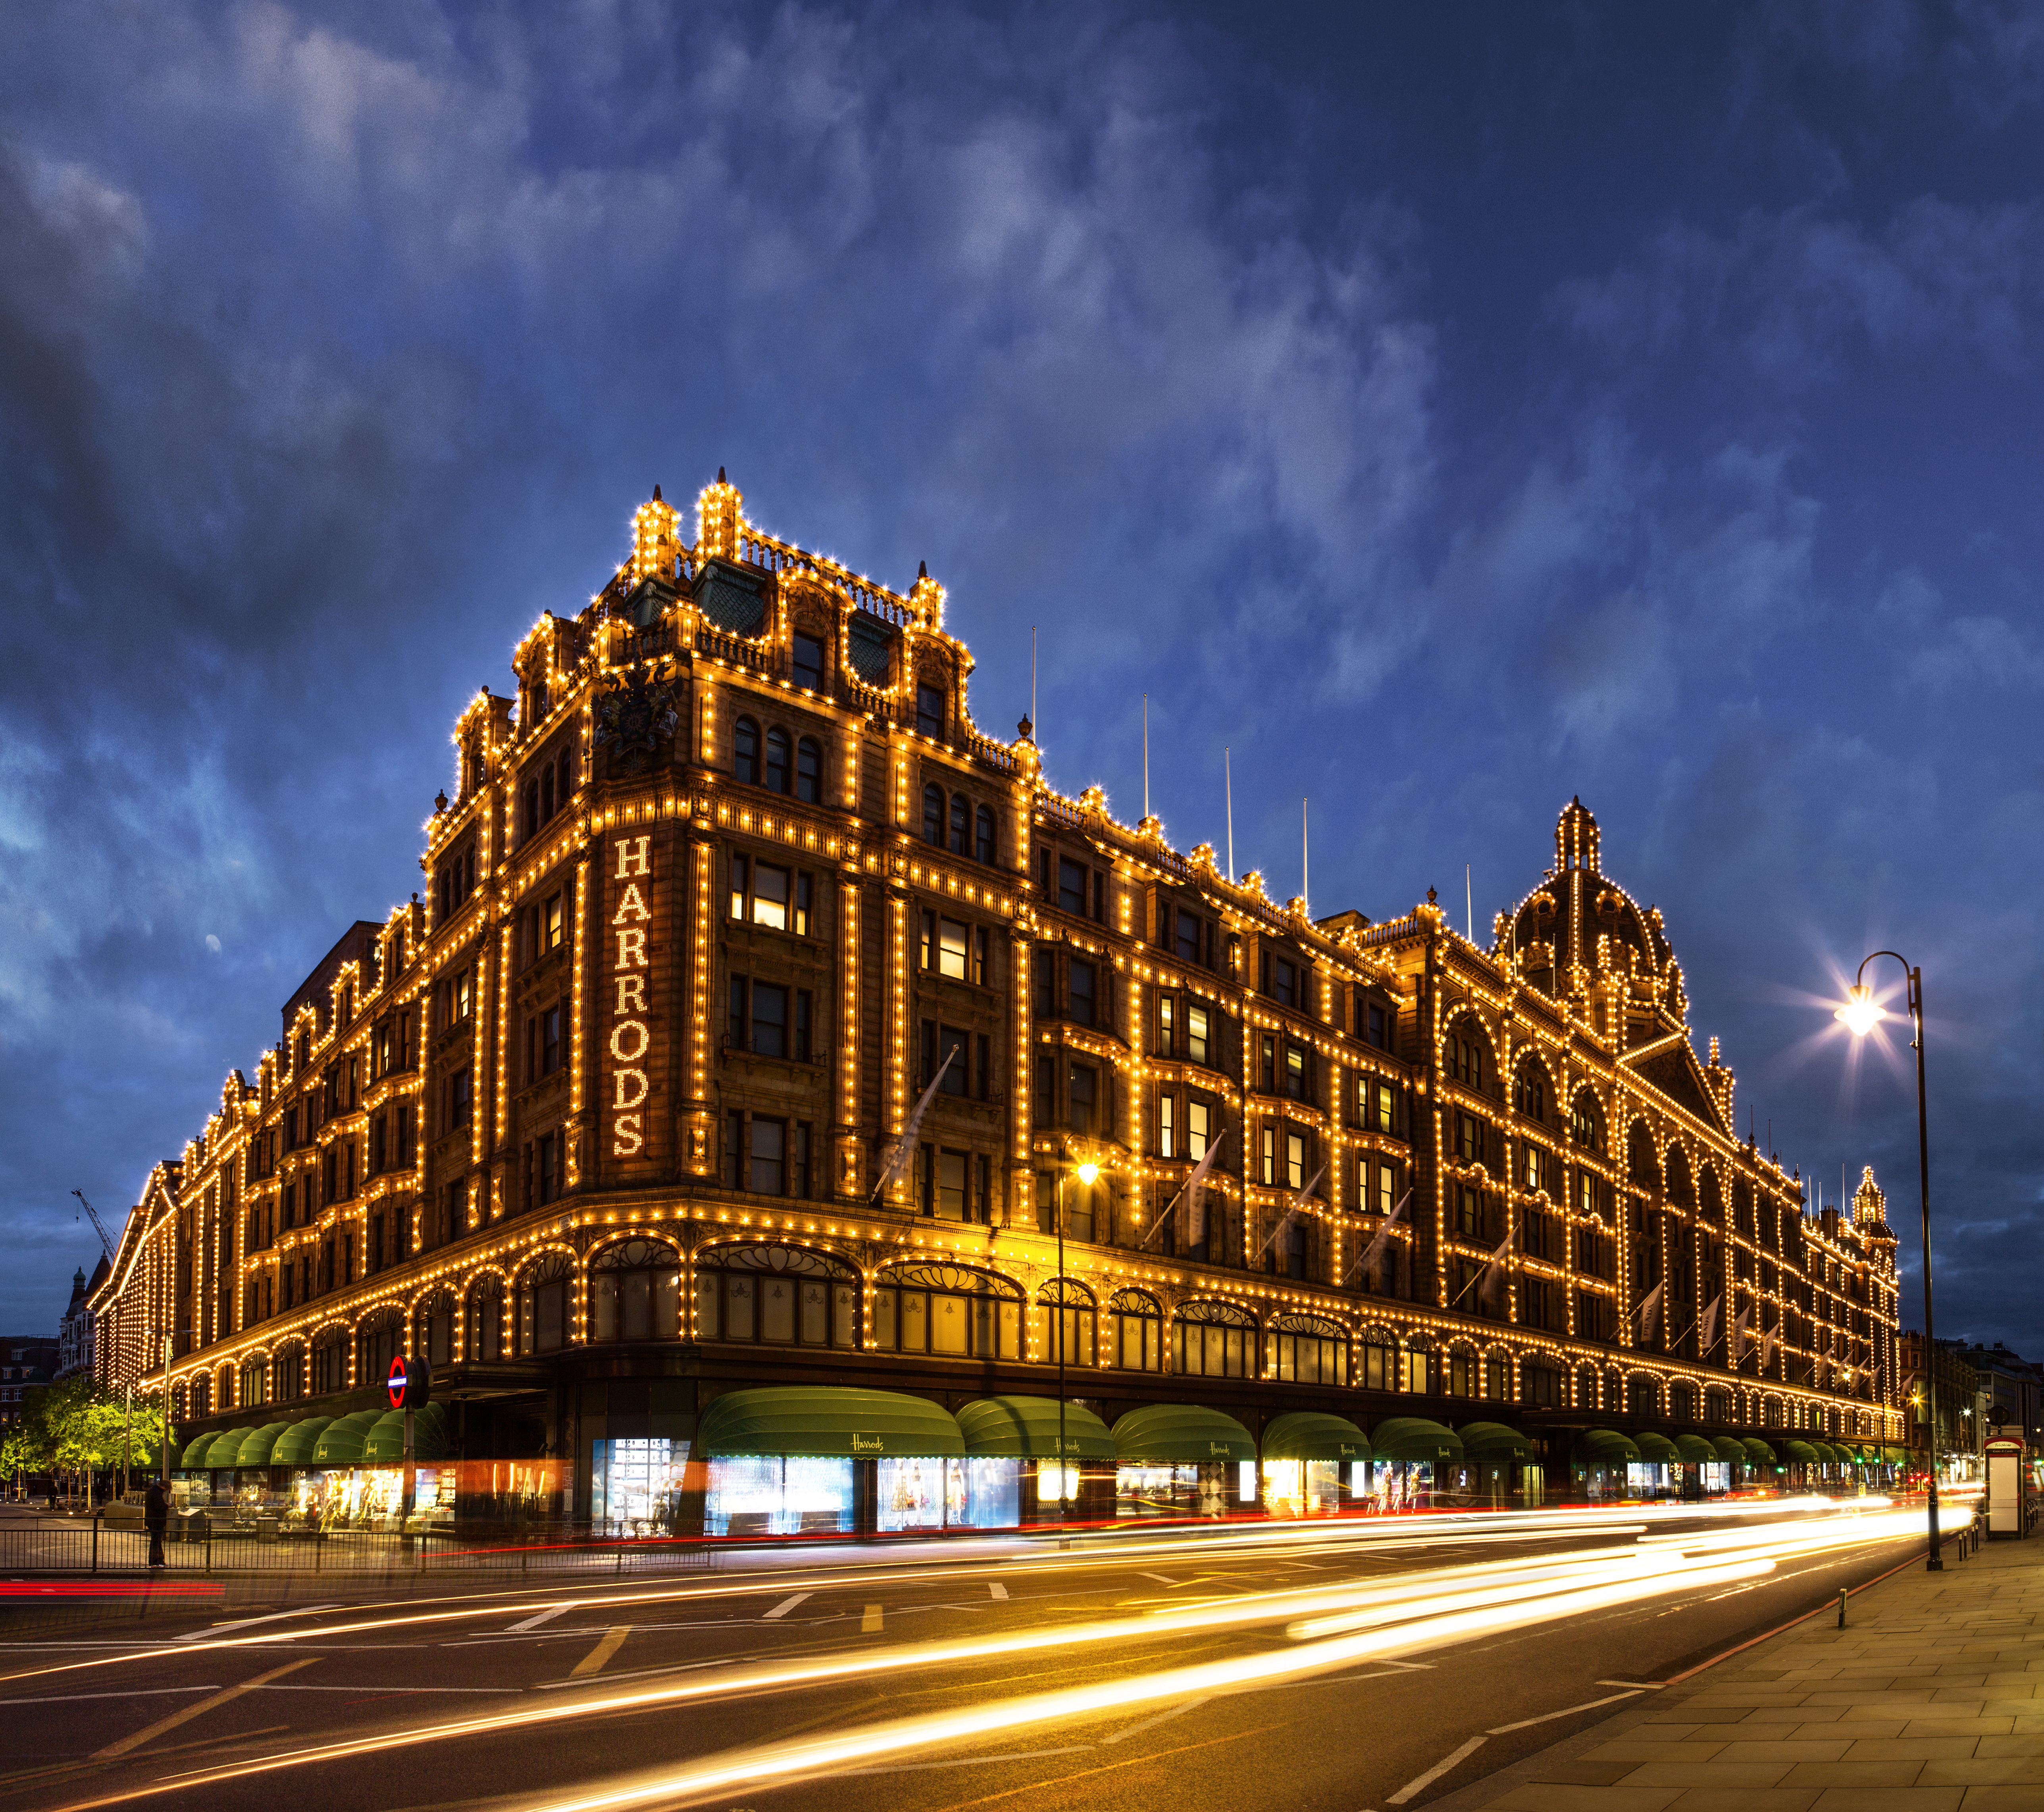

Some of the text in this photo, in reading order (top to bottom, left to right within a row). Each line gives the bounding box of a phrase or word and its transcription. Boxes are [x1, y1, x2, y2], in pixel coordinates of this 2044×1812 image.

[610, 836, 651, 1155] HARRODS
[1644, 1303, 1654, 1336] PRADA
[850, 1433, 883, 1451] Harrods
[1054, 1437, 1080, 1452] Hrrods
[1209, 1442, 1230, 1456] Harrods
[1340, 1444, 1356, 1456] Harrods
